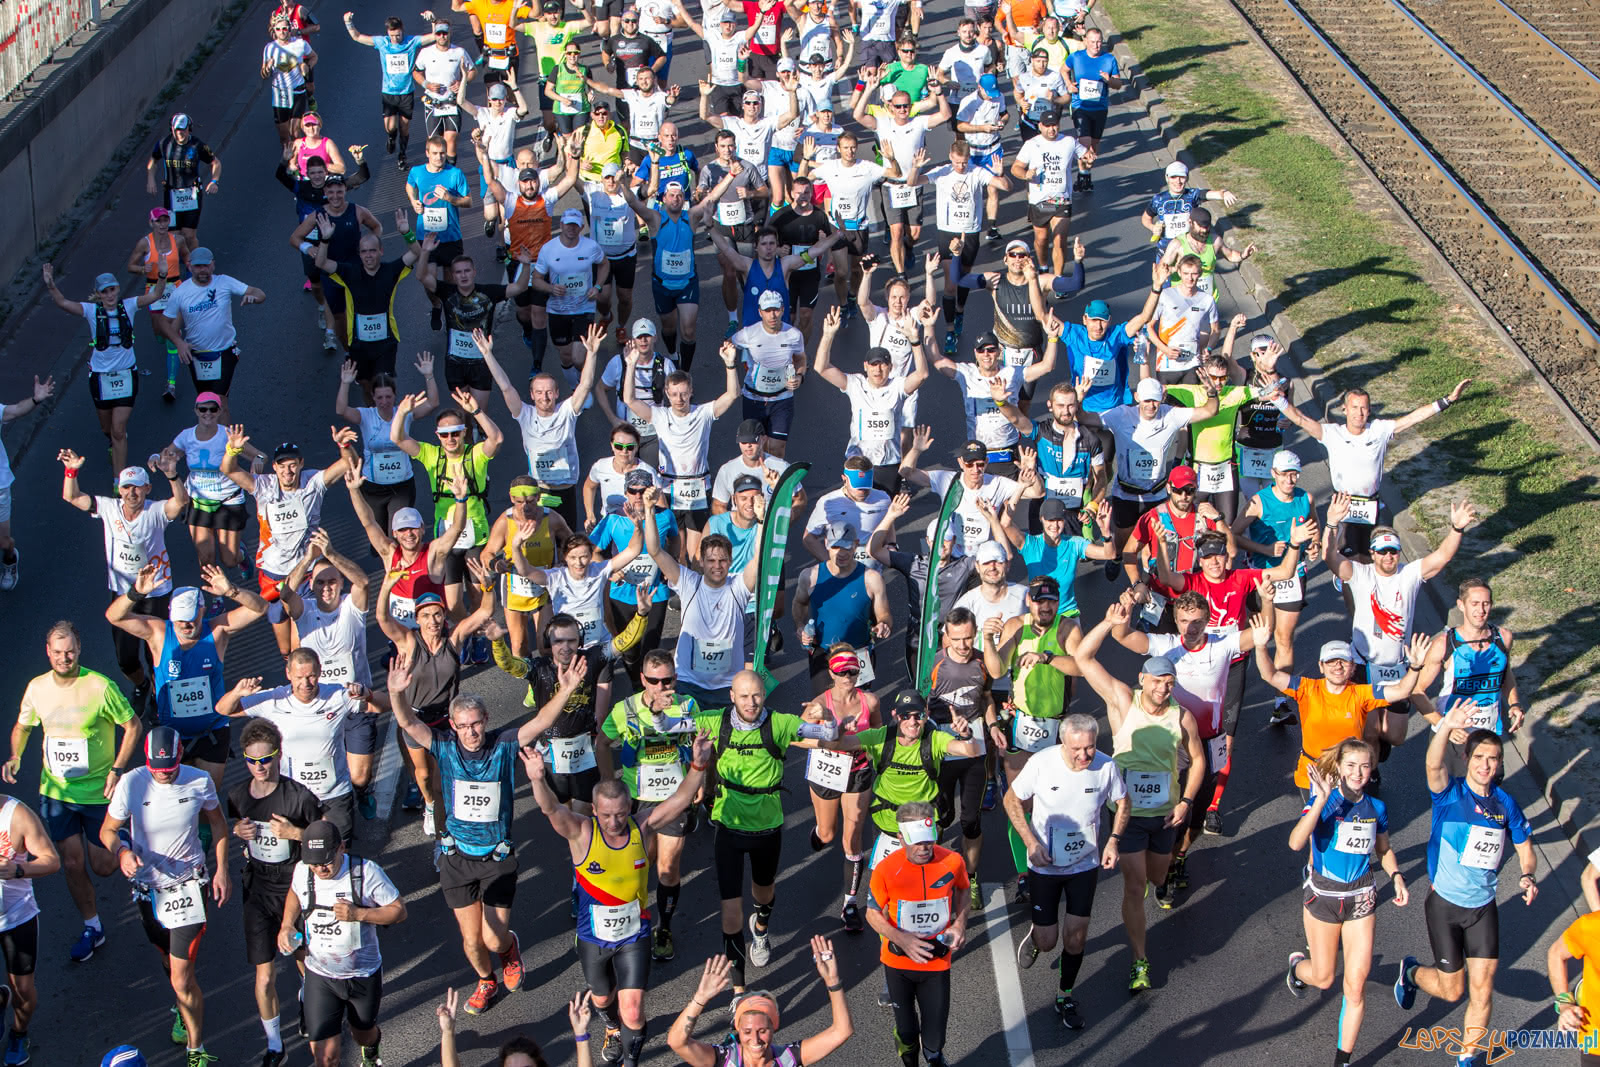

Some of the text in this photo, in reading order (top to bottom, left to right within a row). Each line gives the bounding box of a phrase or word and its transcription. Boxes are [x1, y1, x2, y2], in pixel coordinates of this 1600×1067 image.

[744, 148, 760, 156] 5184
[665, 259, 684, 267] 3396
[363, 323, 382, 331] 2618
[455, 339, 475, 349] 5396
[888, 336, 907, 346] 3601
[200, 361, 213, 370] 192
[1092, 367, 1109, 376] 1712
[110, 379, 125, 388] 193
[761, 375, 782, 383] 2564
[867, 420, 890, 429] 3589
[378, 461, 401, 471] 5462
[535, 460, 554, 469] 3312
[1135, 459, 1159, 467] 4398
[1250, 459, 1267, 468] 794
[1207, 472, 1225, 482] 1425
[679, 489, 700, 498] 4487
[1054, 488, 1077, 497] 1440
[274, 509, 298, 521] 3766
[1349, 510, 1369, 519] 1854
[961, 526, 983, 535] 1959
[119, 552, 141, 562] 4146
[629, 565, 653, 574] 4977
[1273, 580, 1294, 590] 670
[701, 651, 725, 661] 1677
[321, 666, 348, 678] 3905
[1378, 669, 1401, 679] 1491
[176, 690, 204, 703] 2488
[1022, 725, 1049, 739] 3760
[54, 752, 80, 762] 1093
[561, 747, 586, 760] 4786
[816, 758, 842, 776] 3725
[300, 770, 328, 781] 5225
[647, 776, 677, 787] 2904
[1133, 783, 1161, 794] 1488
[463, 795, 491, 807] 2159
[1064, 840, 1086, 852] 629
[1346, 837, 1371, 850] 4217
[1474, 841, 1501, 854] 4279
[165, 896, 194, 913] 2022
[603, 914, 632, 929] 3791
[910, 912, 941, 924] 1570
[312, 923, 342, 937] 3256
